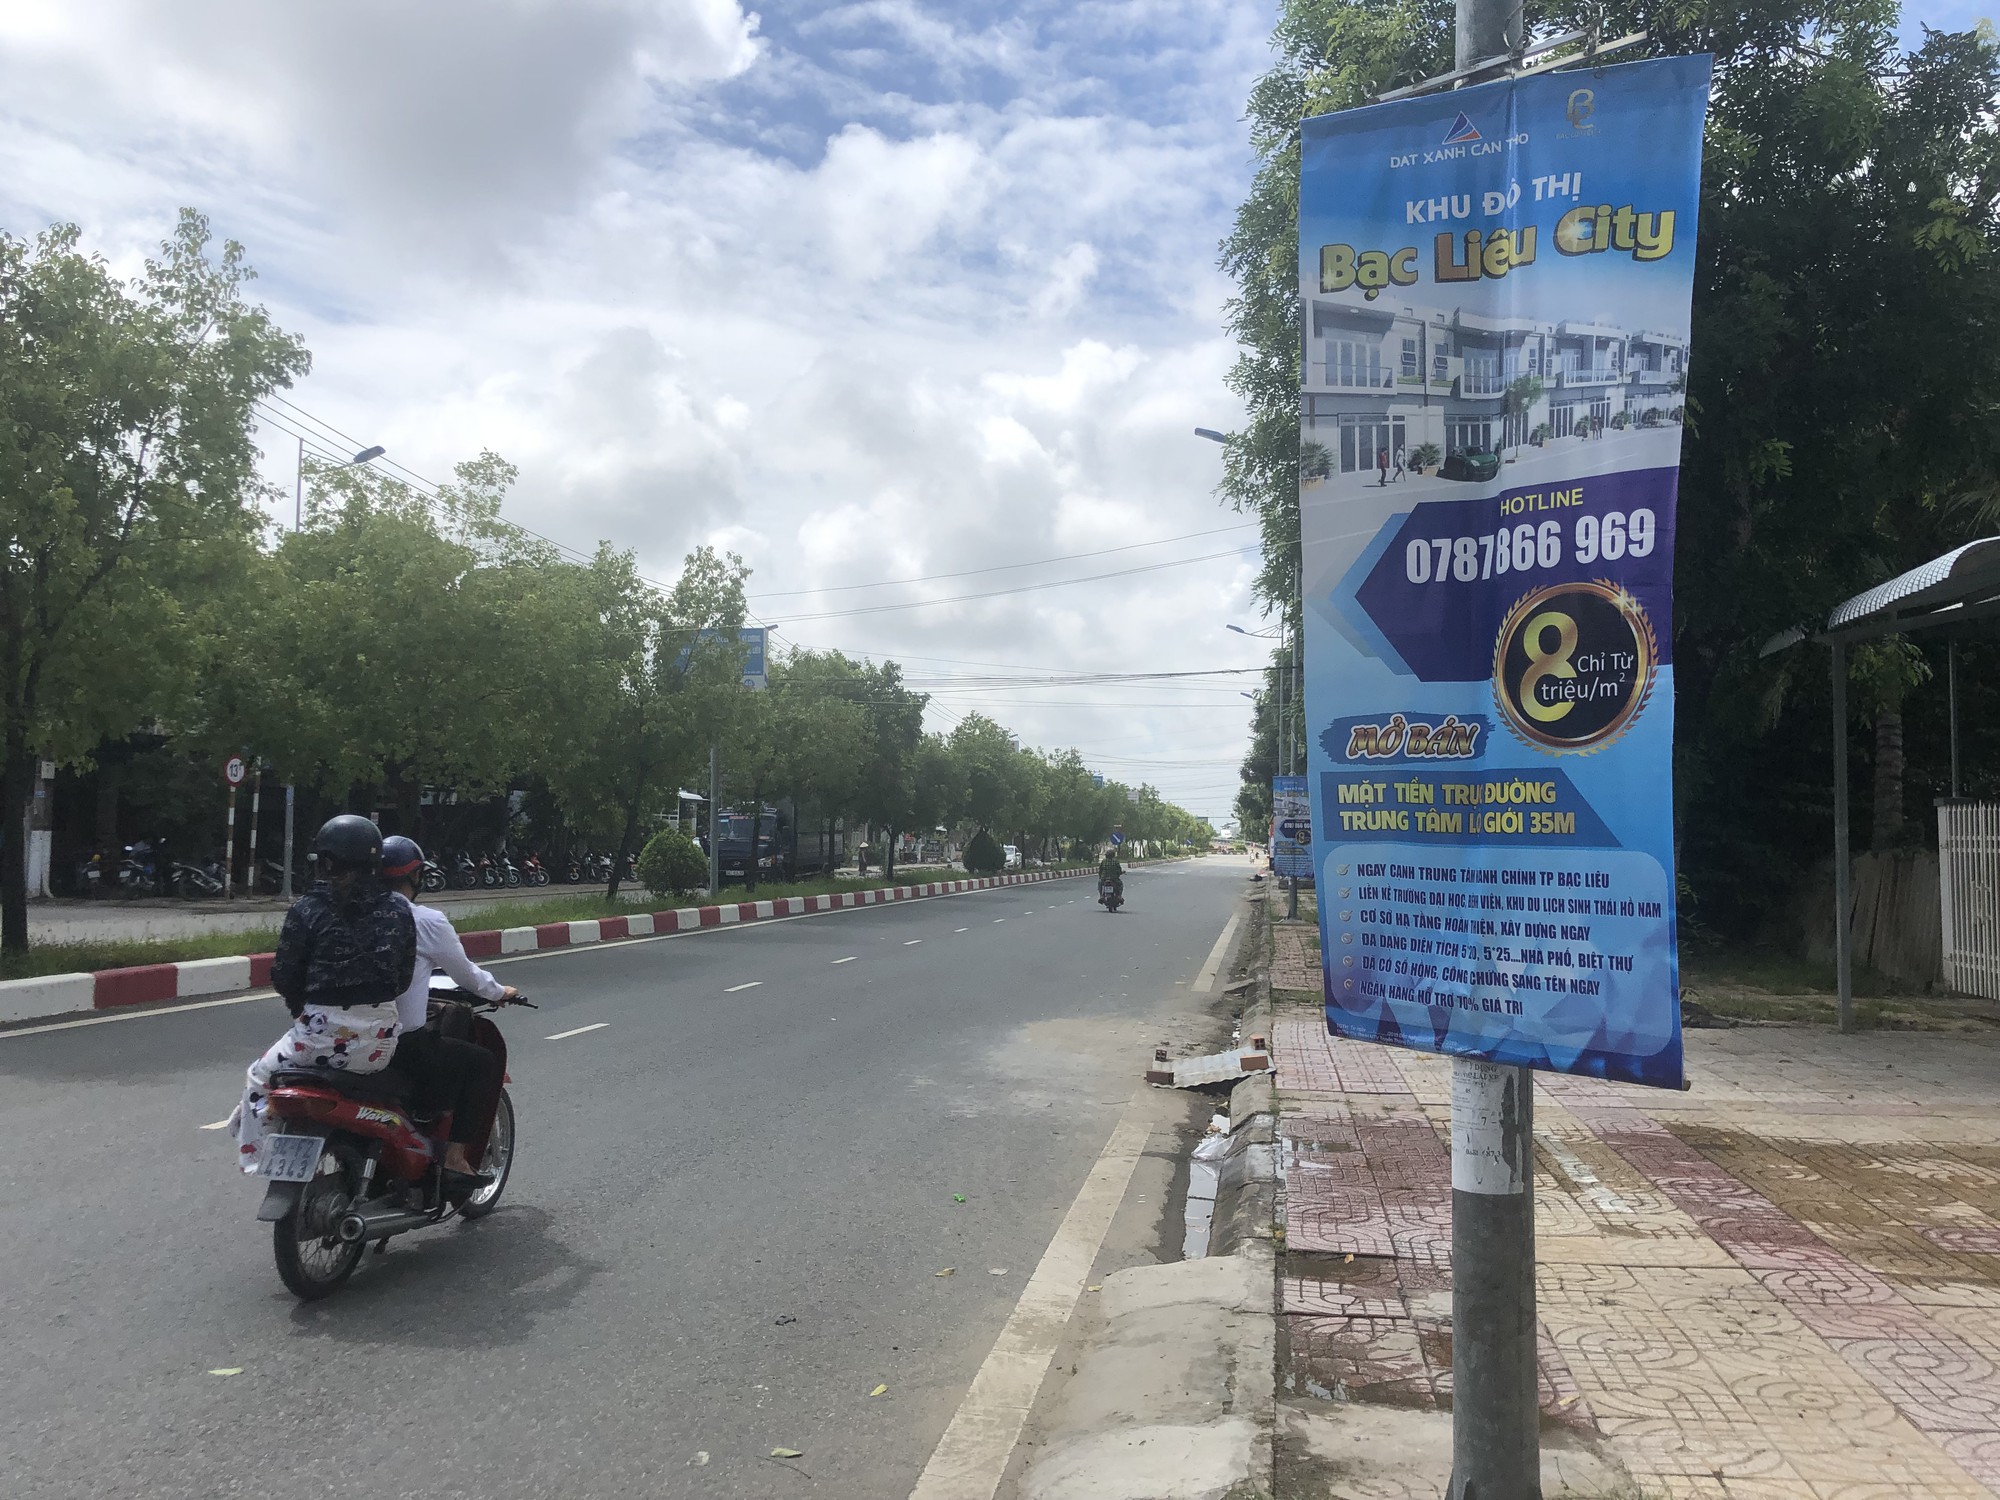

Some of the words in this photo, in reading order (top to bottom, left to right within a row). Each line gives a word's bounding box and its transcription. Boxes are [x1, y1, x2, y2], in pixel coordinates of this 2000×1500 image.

[1390, 154, 1418, 169] DAT
[1423, 146, 1466, 164] XANH
[1470, 140, 1502, 157] CAN
[1406, 194, 1471, 224] KHU
[1532, 172, 1582, 202] THỊ
[1320, 243, 1419, 301] Bạc
[1434, 225, 1537, 284] Liêu
[1554, 204, 1676, 262] City
[1500, 488, 1584, 517] HOTLINE
[1575, 508, 1656, 564] 969
[1519, 611, 1579, 722] 8
[1577, 652, 1605, 673] Chỉ
[1610, 651, 1635, 670] Từ
[1346, 714, 1406, 759] MỞ
[1405, 714, 1480, 759] BÁN
[1338, 780, 1387, 808] MẶT
[1394, 776, 1434, 804] TIỀN
[1484, 777, 1557, 805] ĐƯỜNG
[1340, 810, 1409, 831] TRUNG
[1414, 808, 1462, 833] TÂM
[1483, 807, 1524, 834] GIỚI
[1530, 812, 1576, 834] 35M
[1357, 864, 1386, 877] NGAY
[1390, 864, 1415, 881] CẠNH
[1418, 867, 1457, 883] TRUNG
[1501, 868, 1536, 885] CHÍNH
[1539, 871, 1554, 886] TP
[1557, 872, 1581, 889] BẠC
[1585, 870, 1610, 888] LIÊU
[1429, 892, 1445, 908] ĐẠI
[1506, 896, 1524, 912] KHU
[1527, 897, 1540, 912] DU
[1543, 898, 1565, 915] LỊCH
[1568, 898, 1591, 914] SINH
[1594, 898, 1617, 916] THÁI
[1638, 902, 1662, 918] NAM
[1360, 908, 1377, 923] CƠ
[1396, 912, 1410, 929] HẠ
[1500, 920, 1520, 937] XÂY
[1524, 922, 1556, 941] DỰNG
[1561, 925, 1590, 941] NGAY
[1361, 933, 1376, 947] ĐA
[1380, 935, 1407, 951] DẠNG
[1410, 937, 1433, 955] DIỆN
[1435, 940, 1459, 957] TÍCH
[1578, 951, 1604, 972] BIỆT
[1608, 954, 1634, 974] THỰ
[1378, 957, 1392, 972] CÓ
[1442, 965, 1468, 984] CÔNG
[1512, 974, 1541, 990] SANG
[1544, 974, 1566, 993] TÊN
[1570, 980, 1600, 996] NGAY
[1389, 984, 1415, 1002] HÀNG
[1434, 992, 1454, 1009] TRỢ
[1482, 997, 1502, 1013] GIÁ
[1505, 1000, 1523, 1018] TRỊ
[355, 1105, 392, 1123] Wave
